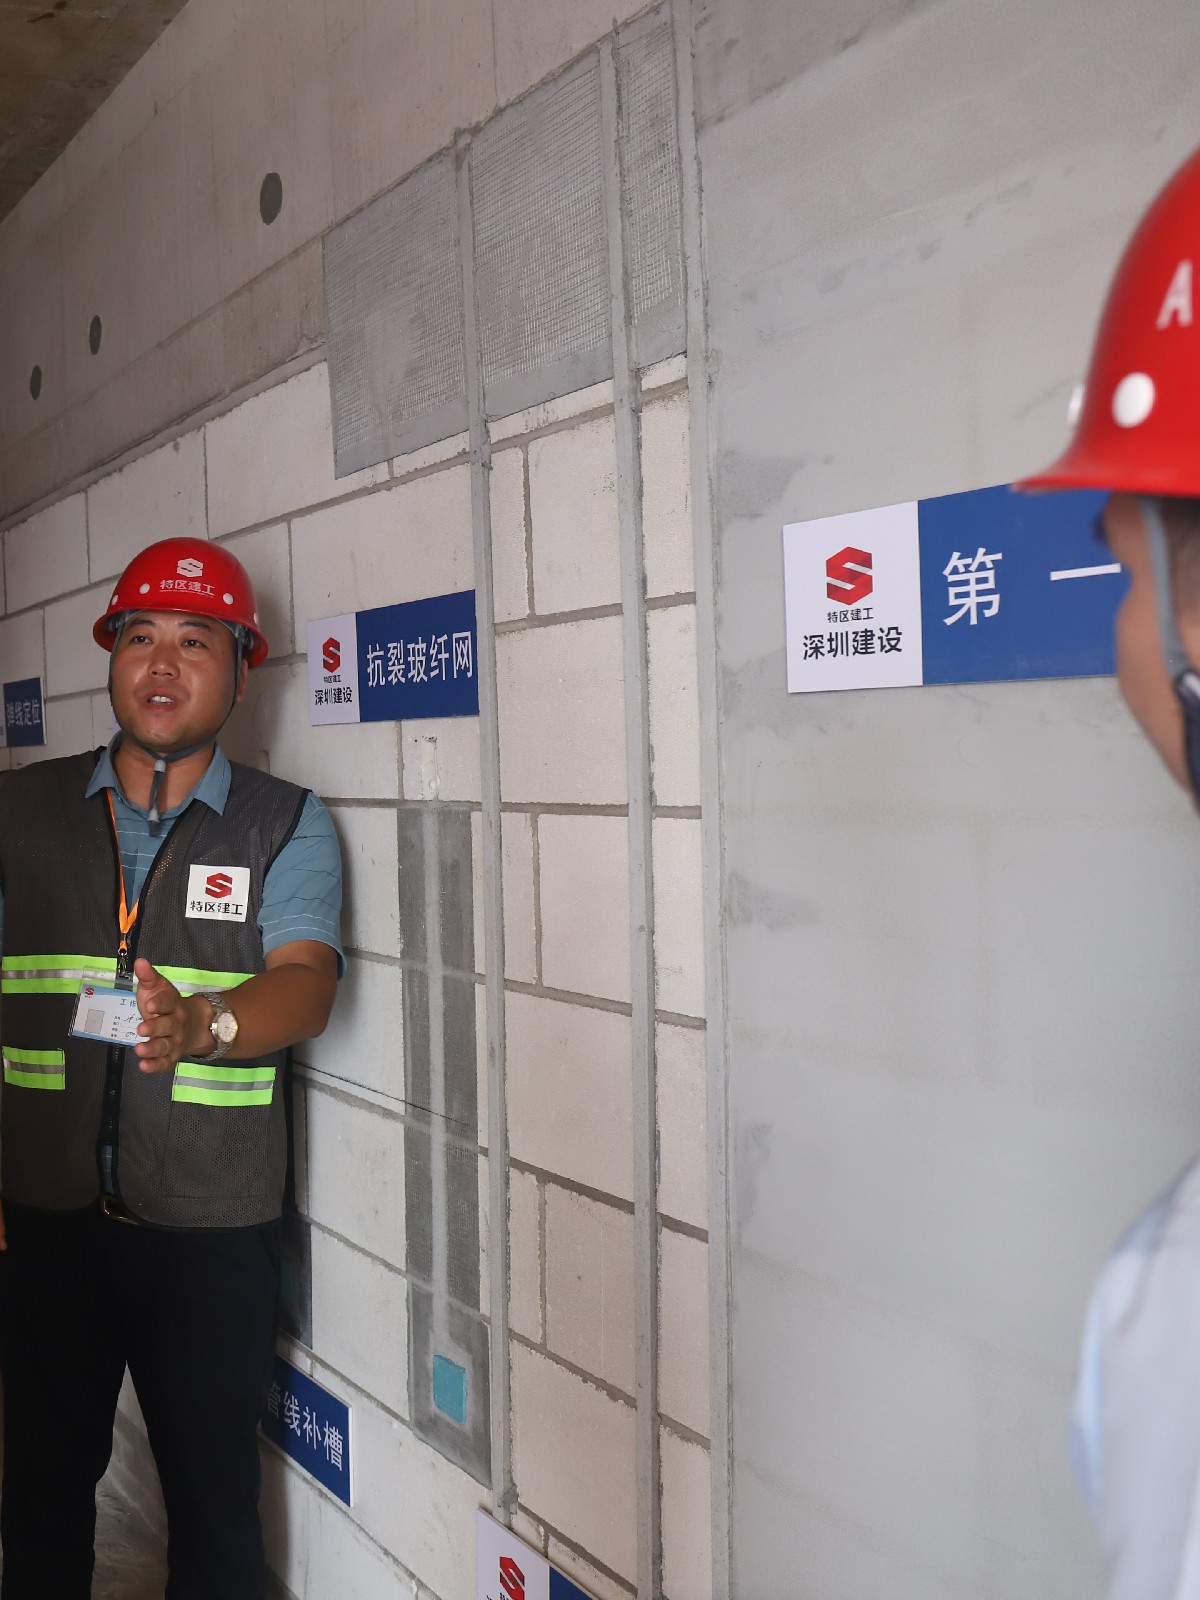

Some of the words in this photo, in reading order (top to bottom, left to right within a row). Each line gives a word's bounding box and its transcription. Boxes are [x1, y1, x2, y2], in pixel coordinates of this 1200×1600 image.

[160, 579, 215, 596] 特区建工
[827, 608, 874, 623] 特区建工
[803, 626, 903, 660] 深圳建设
[366, 630, 473, 688] 抗裂玻纤网
[314, 686, 353, 706] 深圳建设
[190, 900, 243, 916] 特区建工
[267, 1381, 343, 1471] 管线补槽
